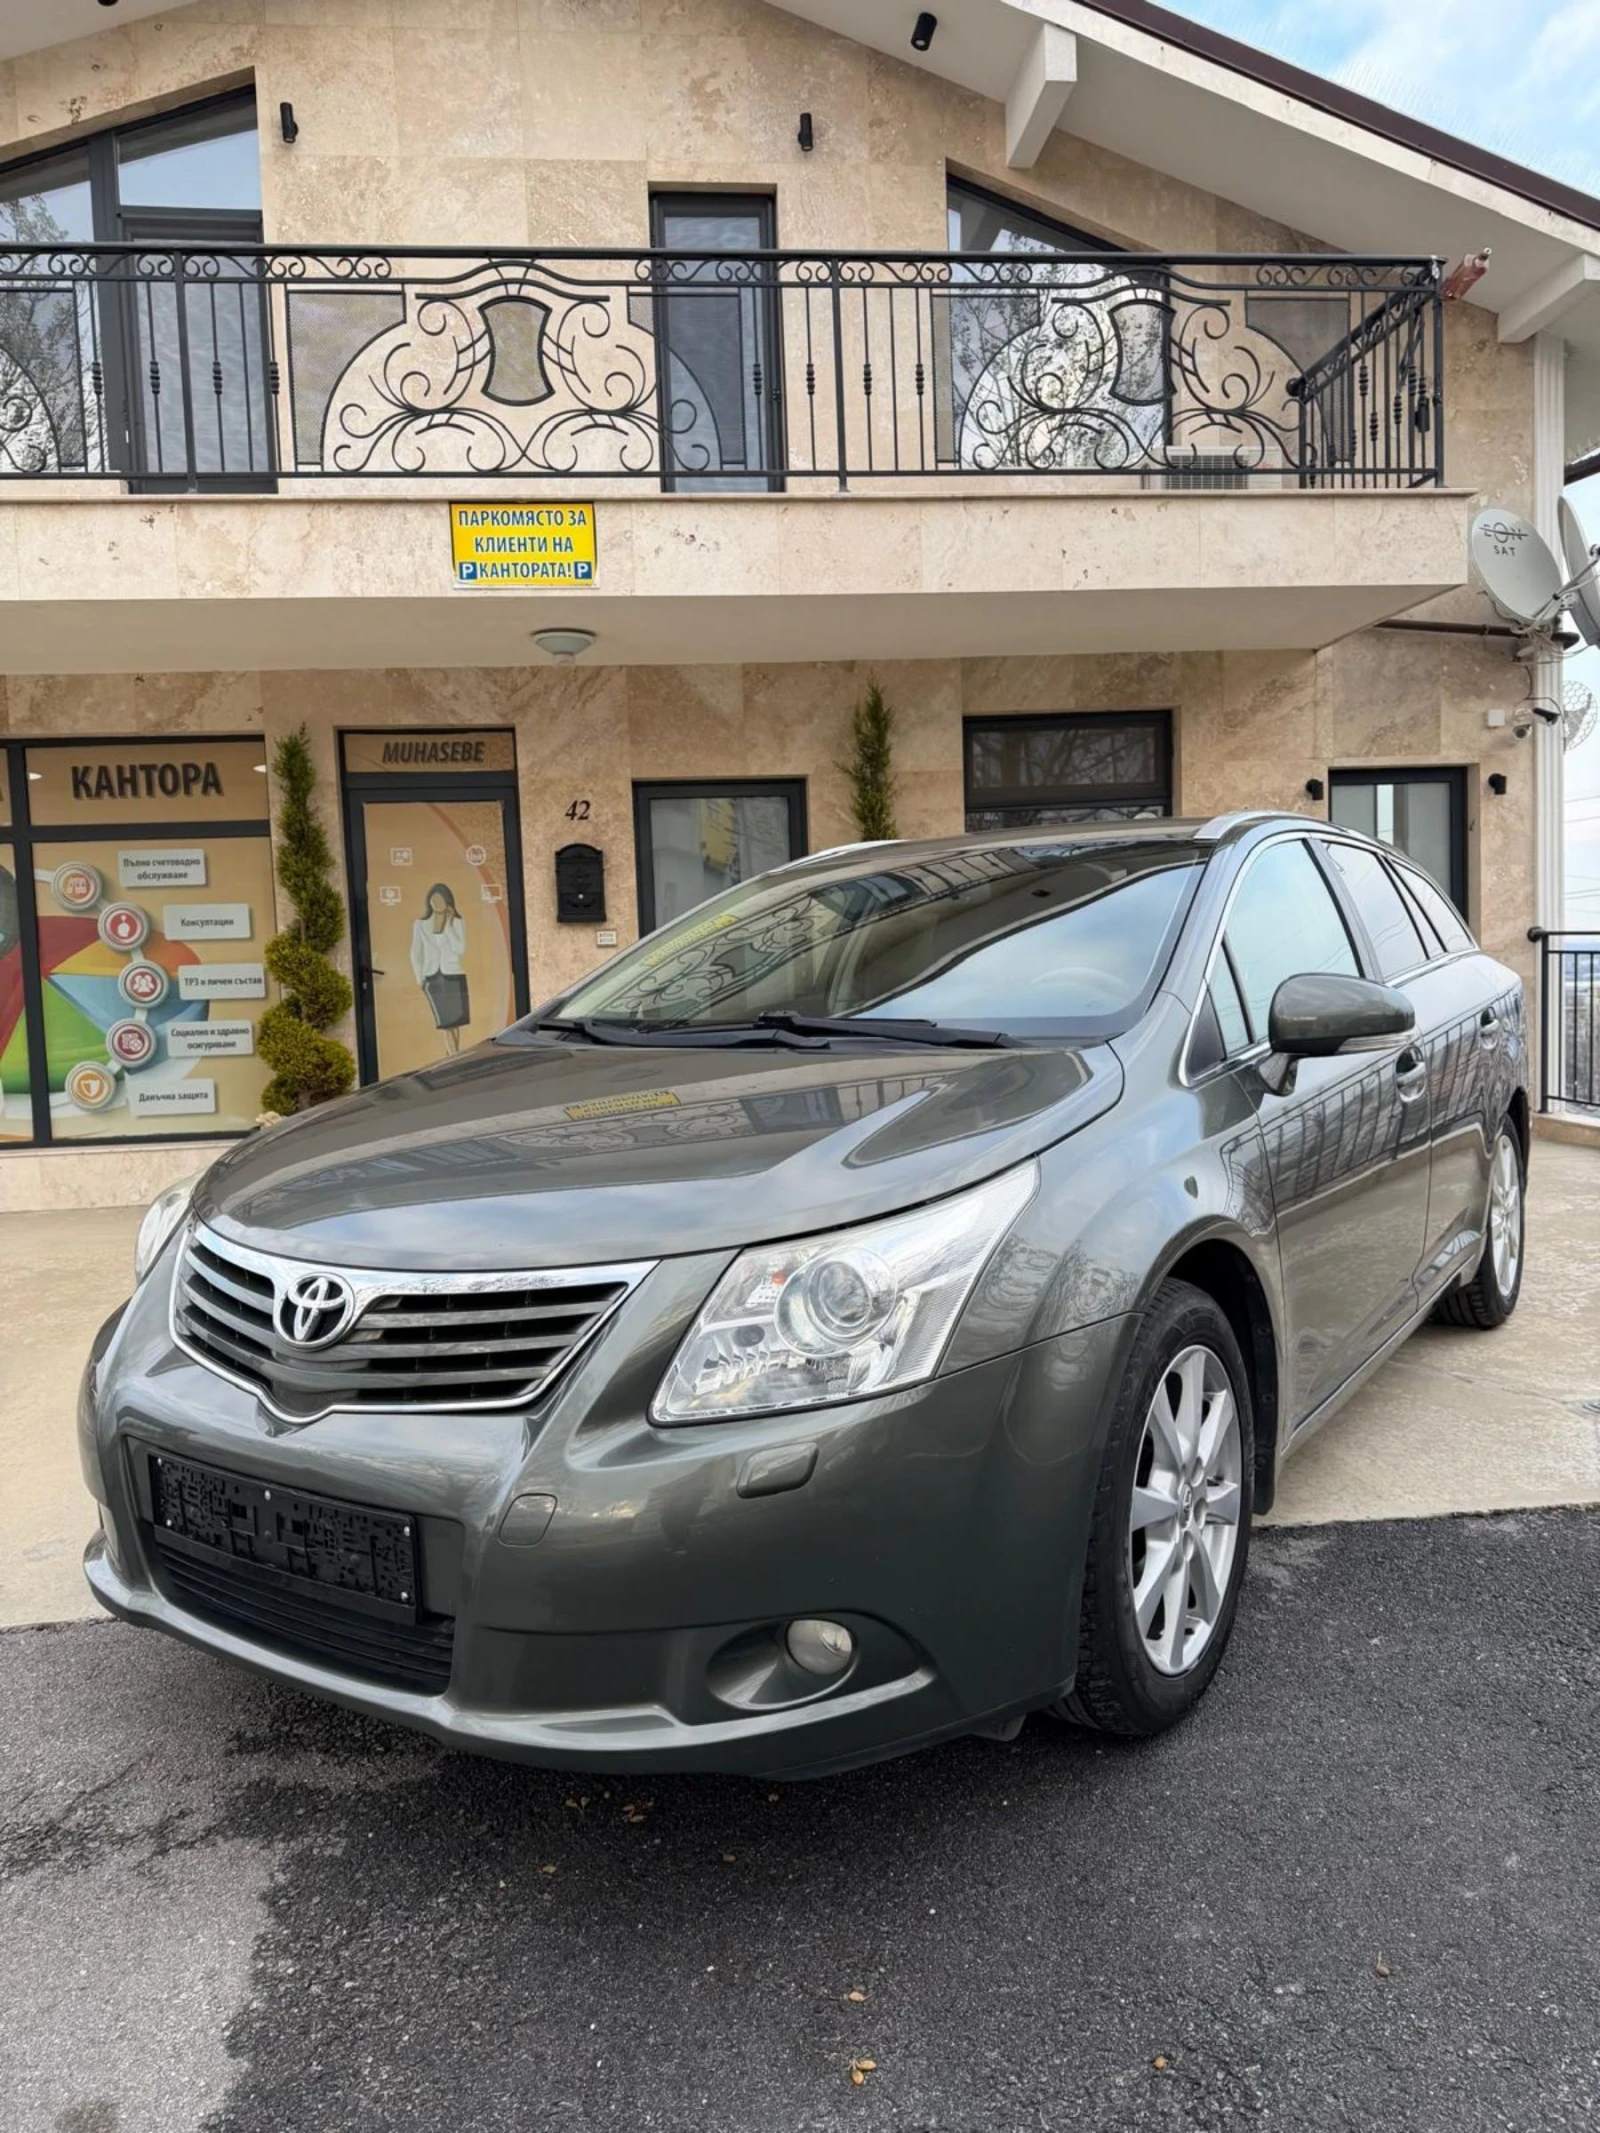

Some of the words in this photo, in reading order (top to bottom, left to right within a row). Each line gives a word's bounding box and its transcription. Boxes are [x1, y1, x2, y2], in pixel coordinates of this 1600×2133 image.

[458, 510, 564, 526] ПАРКОМЯСТО
[568, 510, 587, 526] ЗА
[474, 537, 548, 553] КЛИЕНТИ
[553, 536, 574, 552] НА
[1493, 545, 1516, 556] SAT
[479, 562, 572, 578] КАНТОРАТА!
[382, 741, 486, 763] MUHASEBE
[71, 762, 223, 799] КАНТОРА
[565, 800, 591, 821] 42
[123, 858, 151, 868] Пълно
[152, 858, 201, 867] счетоводно
[137, 870, 188, 881] обслужване
[181, 918, 234, 928] Консултации
[234, 977, 262, 985] състав
[171, 1028, 208, 1038] Социално
[217, 1027, 250, 1037] здравно
[187, 1041, 237, 1051] осигуряване
[138, 1093, 176, 1103] Данъчна
[177, 1091, 209, 1101] защита
